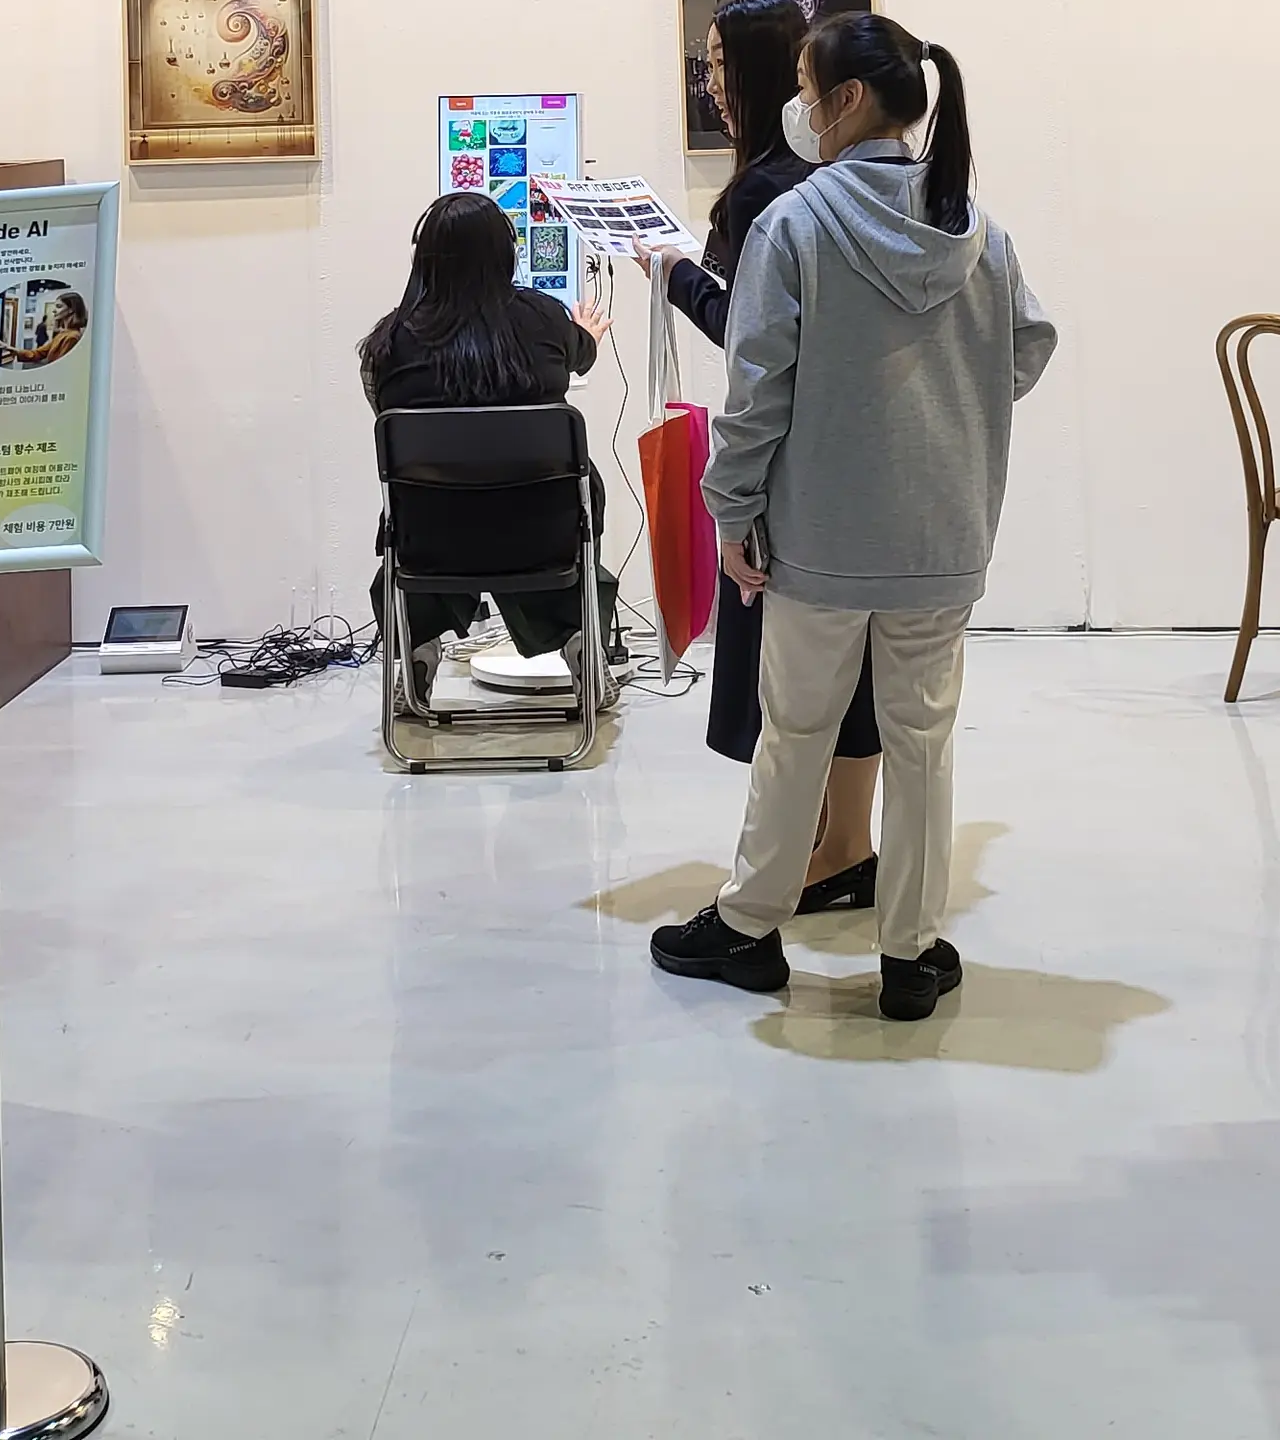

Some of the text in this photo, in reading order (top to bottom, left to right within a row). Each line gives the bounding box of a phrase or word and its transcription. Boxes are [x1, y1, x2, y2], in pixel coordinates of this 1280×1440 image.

[26, 219, 49, 238] AI
[14, 444, 34, 455] 향수
[36, 442, 57, 454] 제조
[3, 518, 75, 534] 체험 비용 7만원
